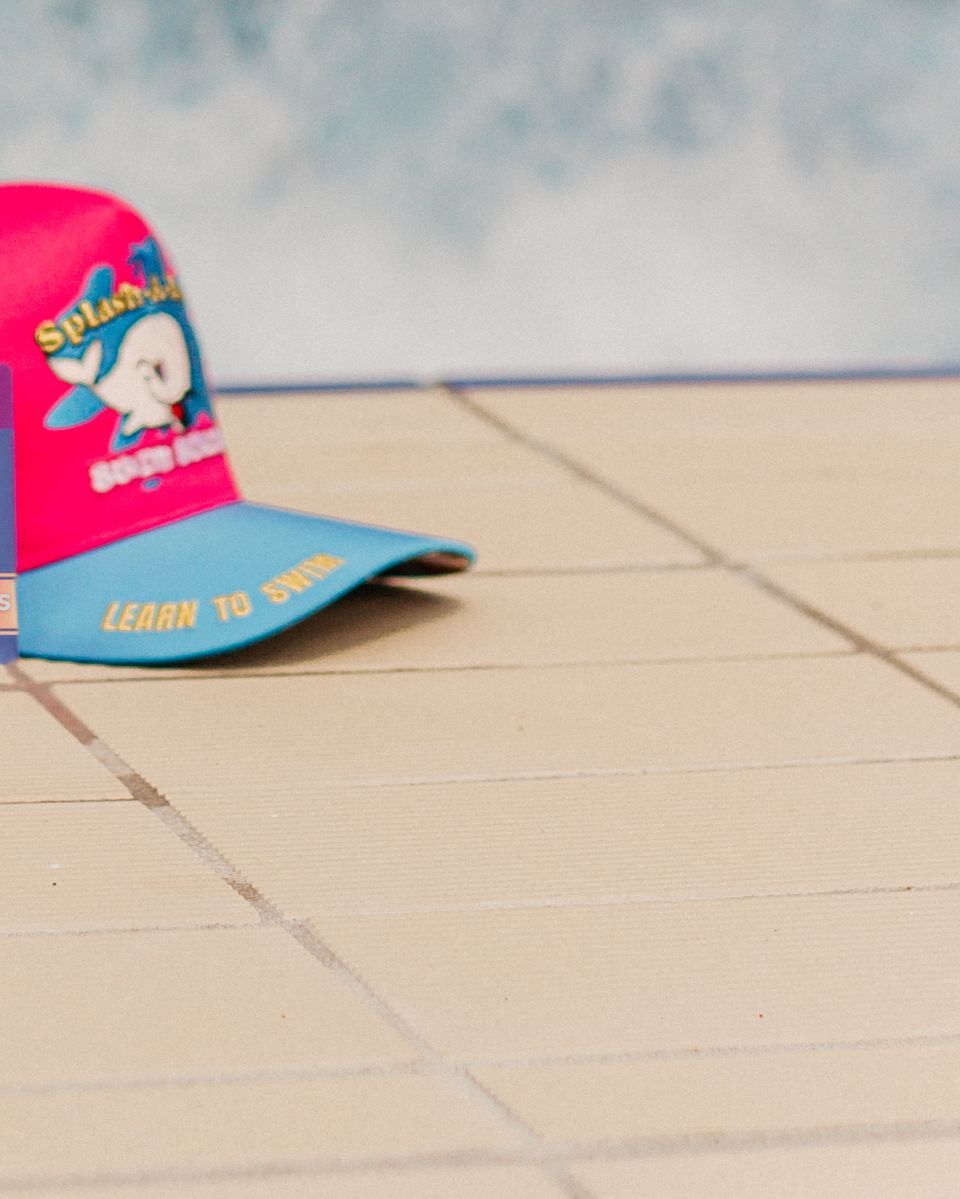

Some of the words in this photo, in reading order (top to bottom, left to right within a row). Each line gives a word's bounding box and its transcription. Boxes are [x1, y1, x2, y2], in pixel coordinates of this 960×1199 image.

[101, 600, 197, 632] LEARN
[213, 591, 252, 622] TO
[260, 552, 345, 605] SWIM
